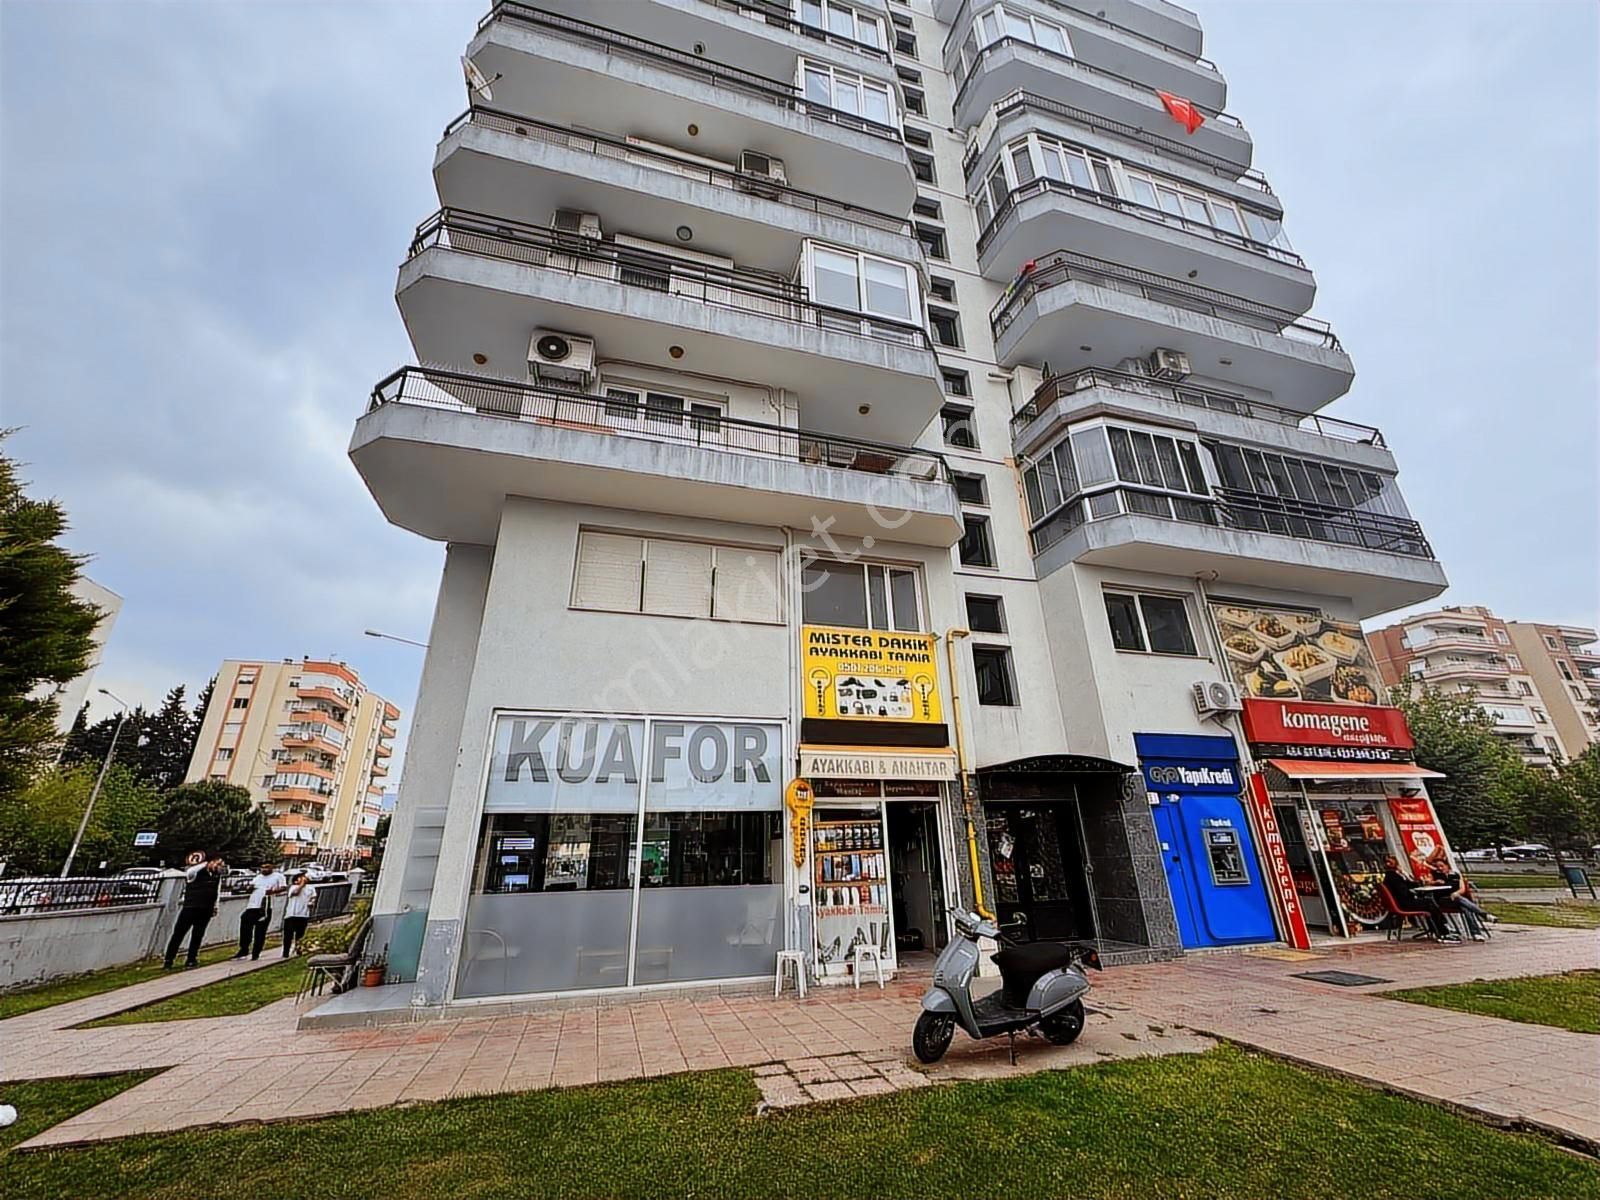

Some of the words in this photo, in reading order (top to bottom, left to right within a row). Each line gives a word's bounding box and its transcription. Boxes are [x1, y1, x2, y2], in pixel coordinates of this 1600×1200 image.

[810, 647, 882, 660] AYAKKABI
[1281, 705, 1370, 737] komagene
[811, 758, 875, 774] AYAKKABI
[879, 759, 887, 774] &
[1263, 803, 1296, 913] komagene
